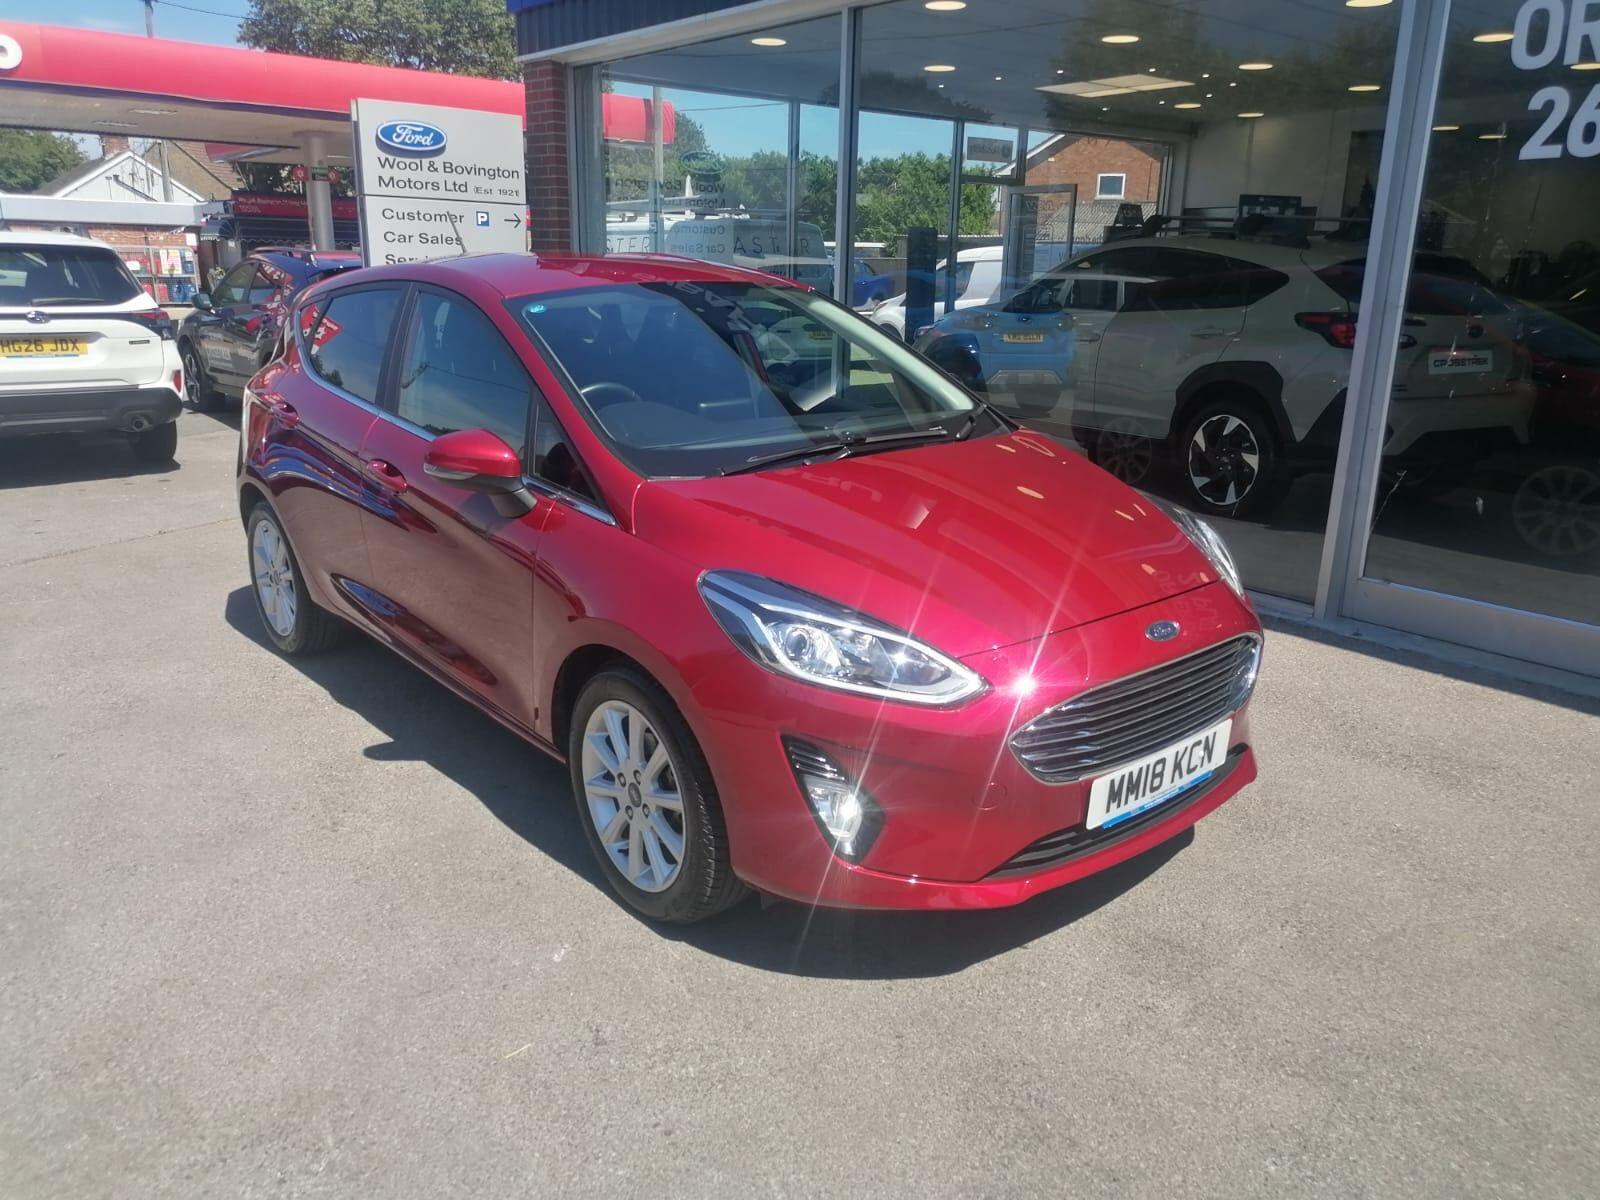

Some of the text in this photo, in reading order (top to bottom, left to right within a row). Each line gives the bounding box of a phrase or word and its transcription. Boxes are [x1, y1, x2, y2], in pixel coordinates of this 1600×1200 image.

[1518, 83, 1600, 161] 26
[392, 124, 435, 147] Ford
[377, 156, 520, 181] Wool & Bovington
[377, 175, 440, 192] Motors
[444, 179, 468, 194] Ltd
[381, 207, 465, 224] Customer
[383, 230, 463, 246] Car Sales
[0, 338, 80, 353] HG26 JDX
[1105, 731, 1217, 814] MM18 KCN
